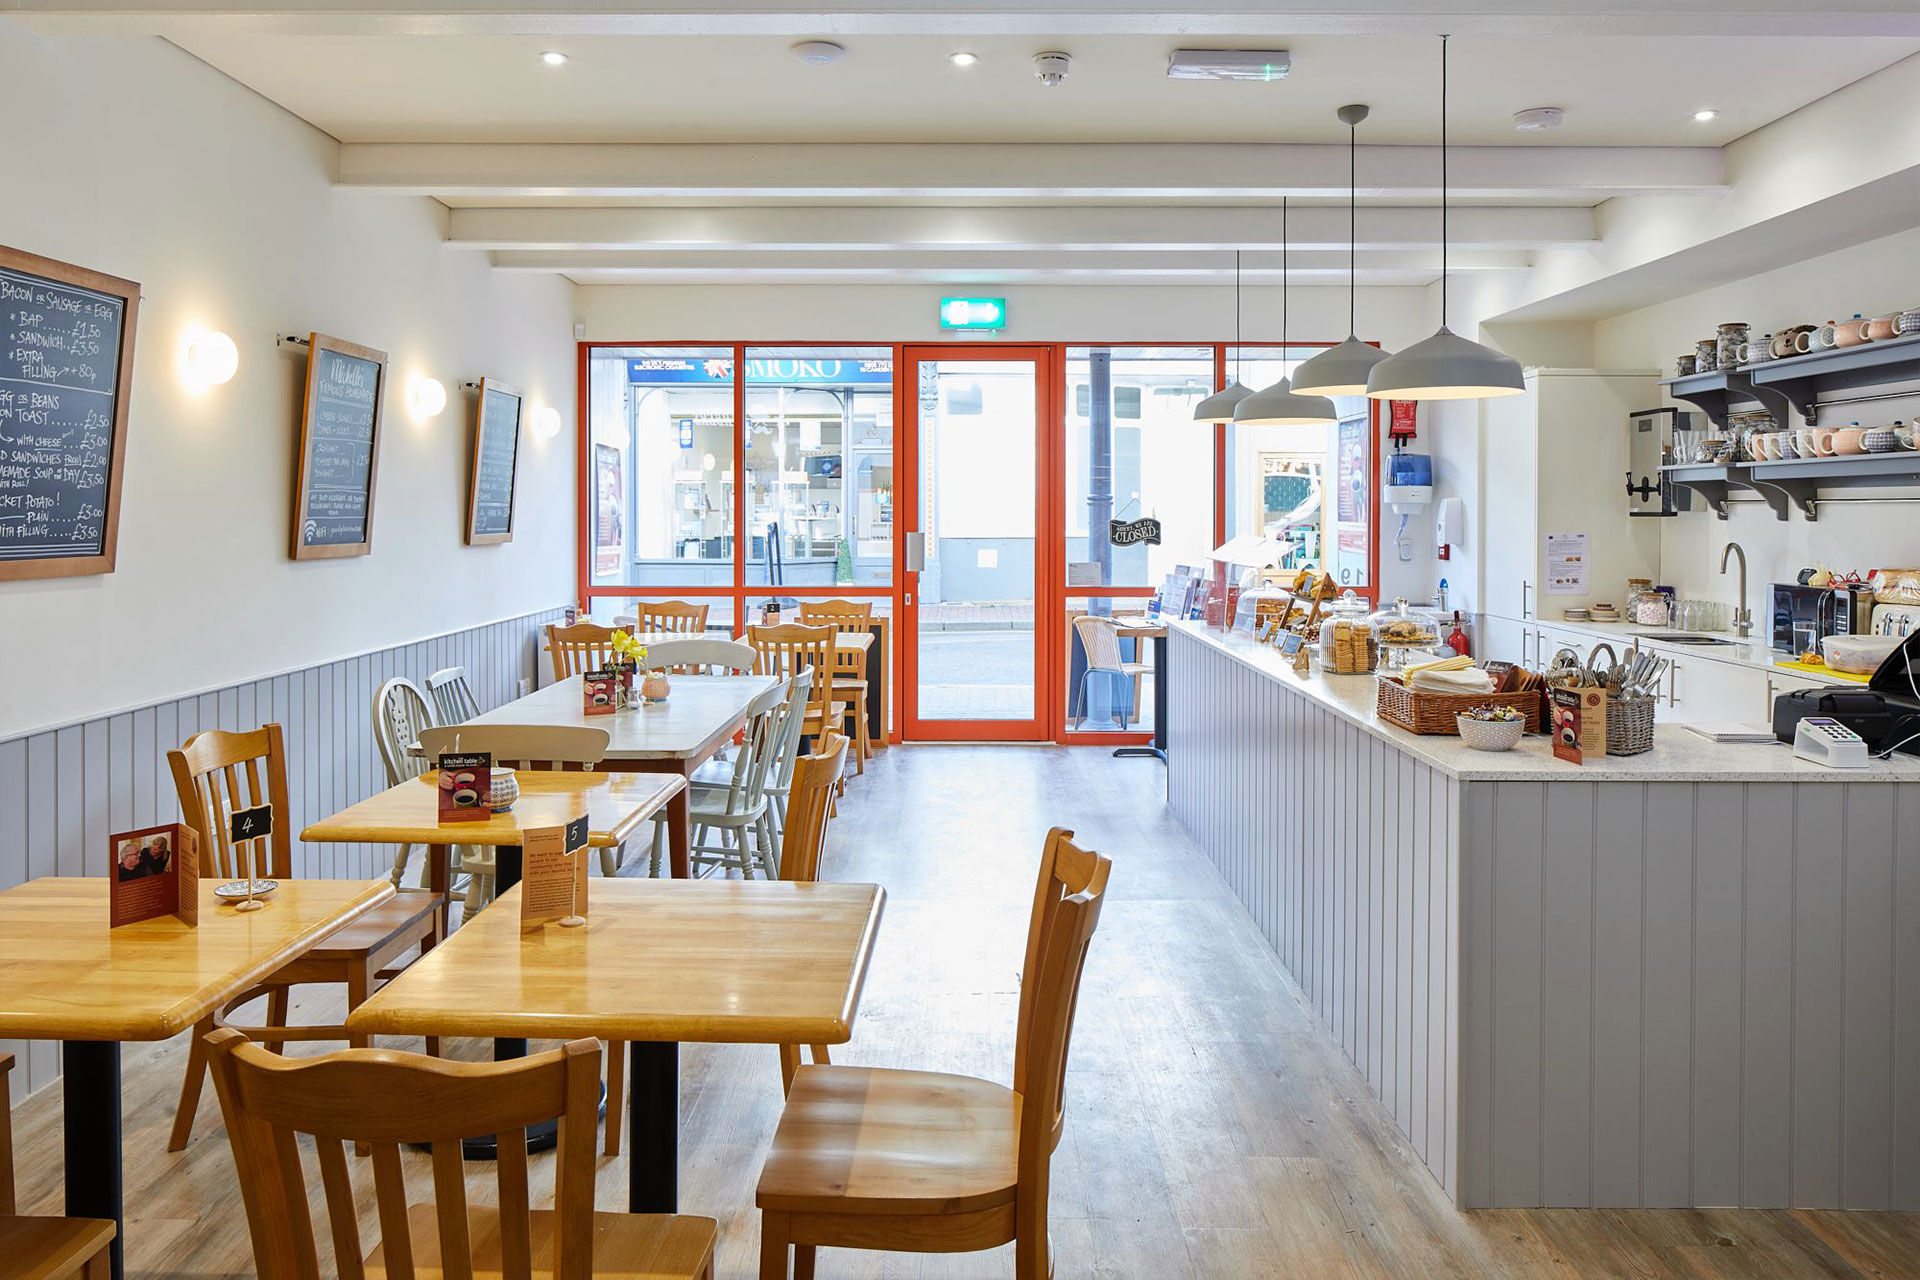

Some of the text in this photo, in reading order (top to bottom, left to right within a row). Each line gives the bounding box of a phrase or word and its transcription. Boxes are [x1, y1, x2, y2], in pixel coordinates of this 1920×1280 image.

[1, 281, 33, 302] BACON
[46, 291, 82, 316] SAUSAGE
[94, 303, 113, 322] EGG
[19, 311, 43, 327] BAP
[70, 339, 99, 356] £3.50
[16, 348, 44, 365] EXTRA
[22, 364, 57, 382] FILLING
[30, 392, 59, 409] BEANS
[0, 408, 109, 429] ON TOAST £2.50
[35, 438, 62, 449] CHEESE
[80, 432, 107, 450] £3.00
[82, 451, 106, 468] £2.00
[33, 467, 53, 480] SOUP
[63, 468, 80, 484] DAY
[77, 470, 104, 489] £3.50
[77, 503, 102, 520] £3.00
[71, 523, 98, 540] £3.50
[1115, 525, 1156, 543] CLOSED
[241, 816, 253, 833] 4
[571, 825, 578, 841] 5
